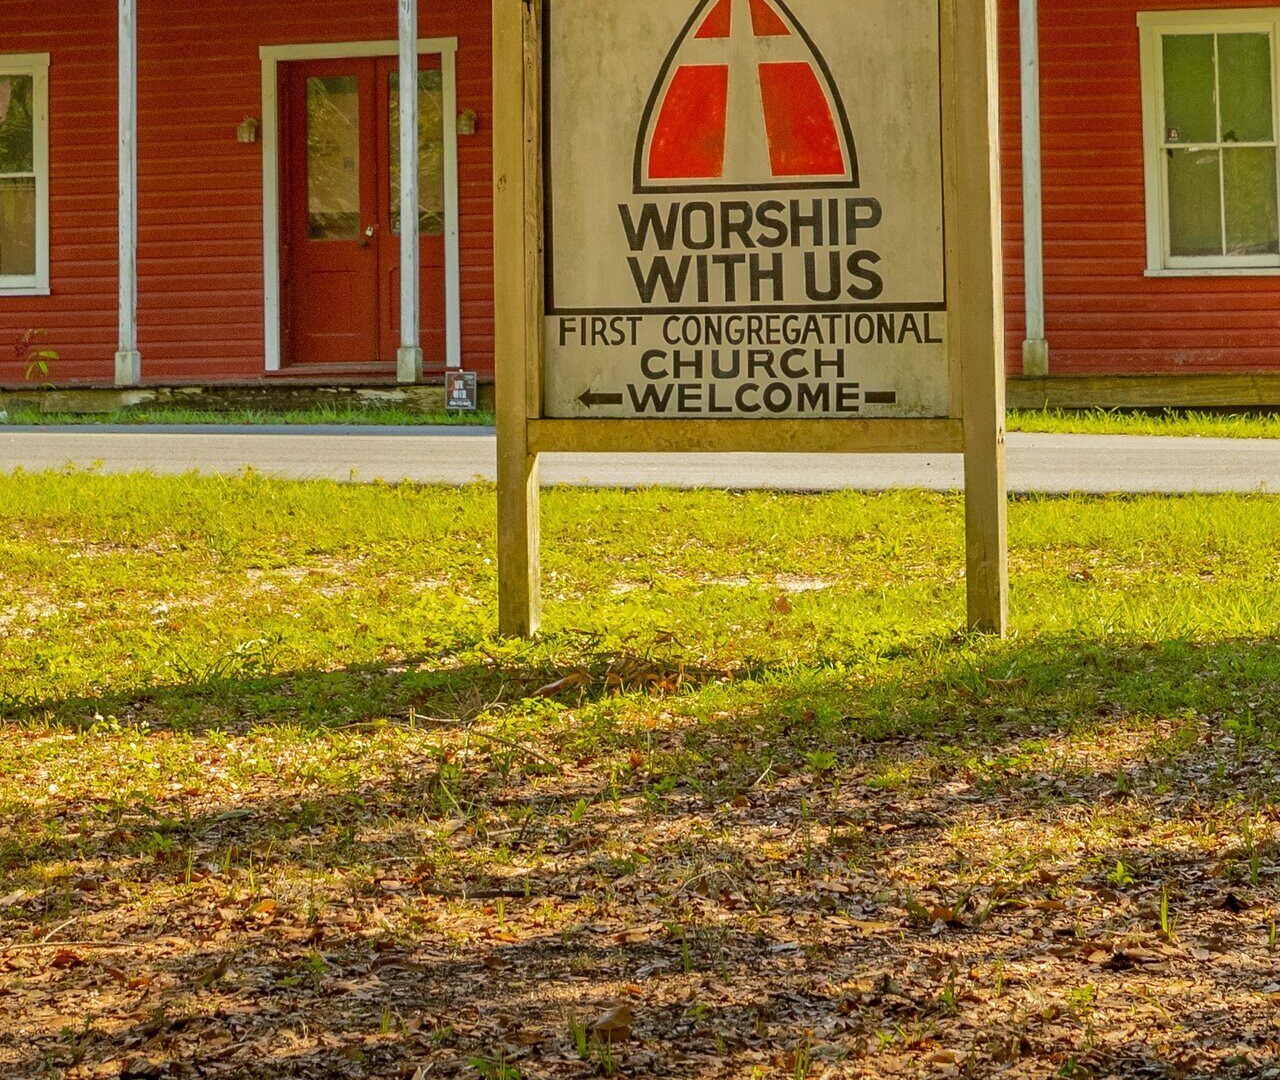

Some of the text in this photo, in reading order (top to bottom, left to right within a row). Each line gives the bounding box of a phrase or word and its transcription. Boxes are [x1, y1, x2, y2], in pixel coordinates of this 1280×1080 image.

[617, 197, 883, 251] WORSHIP
[626, 250, 884, 304] WITH US
[558, 313, 943, 347] FIRST CONGREGATIONAL
[639, 348, 846, 380] CHURCH
[626, 382, 860, 414] WELCOME
